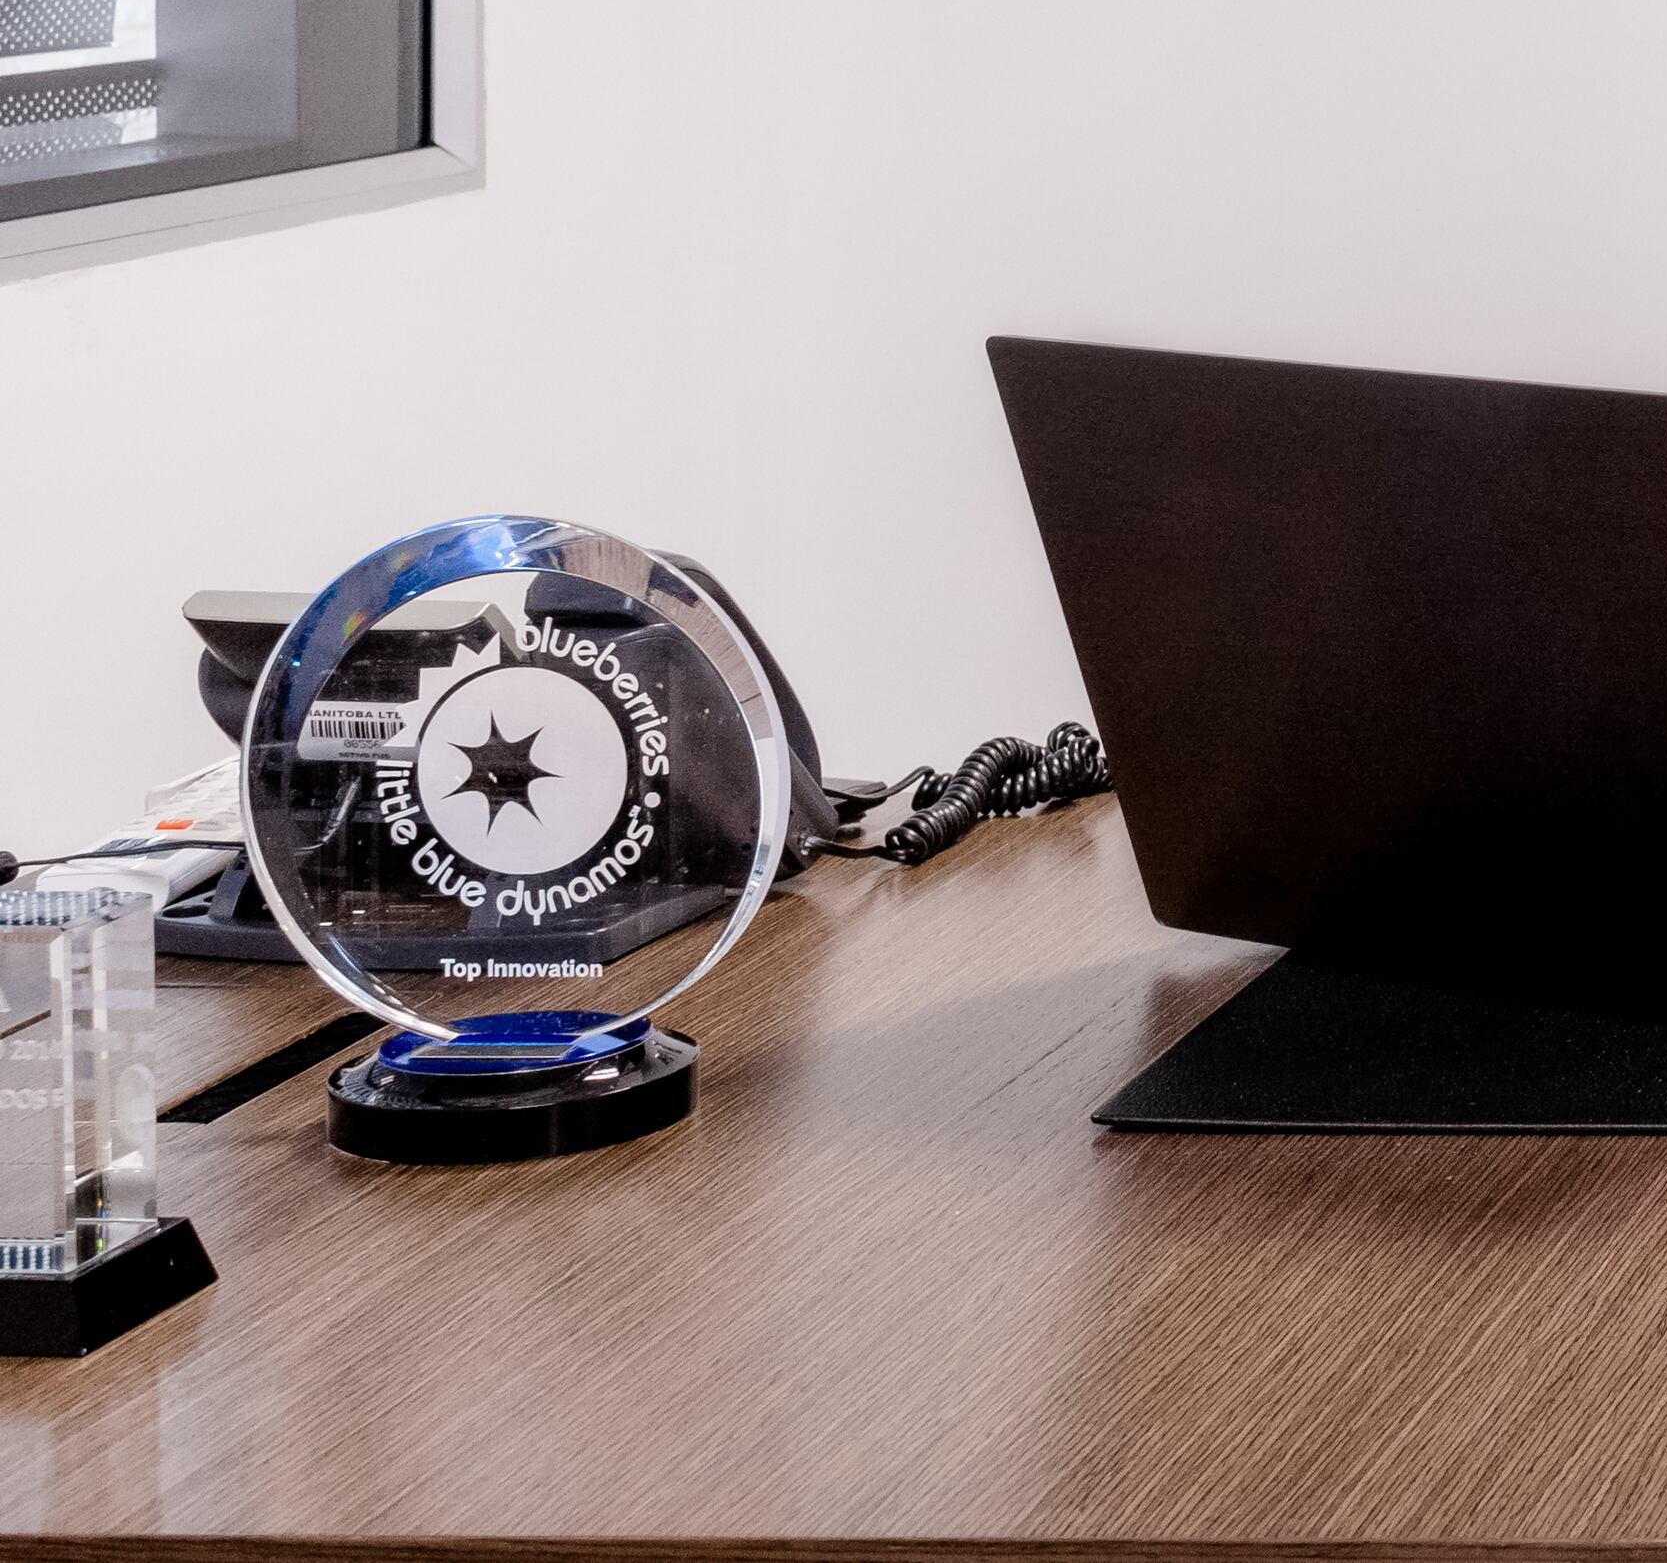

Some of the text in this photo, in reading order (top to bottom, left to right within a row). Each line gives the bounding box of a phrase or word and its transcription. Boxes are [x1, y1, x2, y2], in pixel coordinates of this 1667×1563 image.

[516, 617, 669, 777] blueberries
[376, 760, 420, 845] little
[412, 838, 487, 907] blue
[440, 958, 603, 981] Top Innovation
